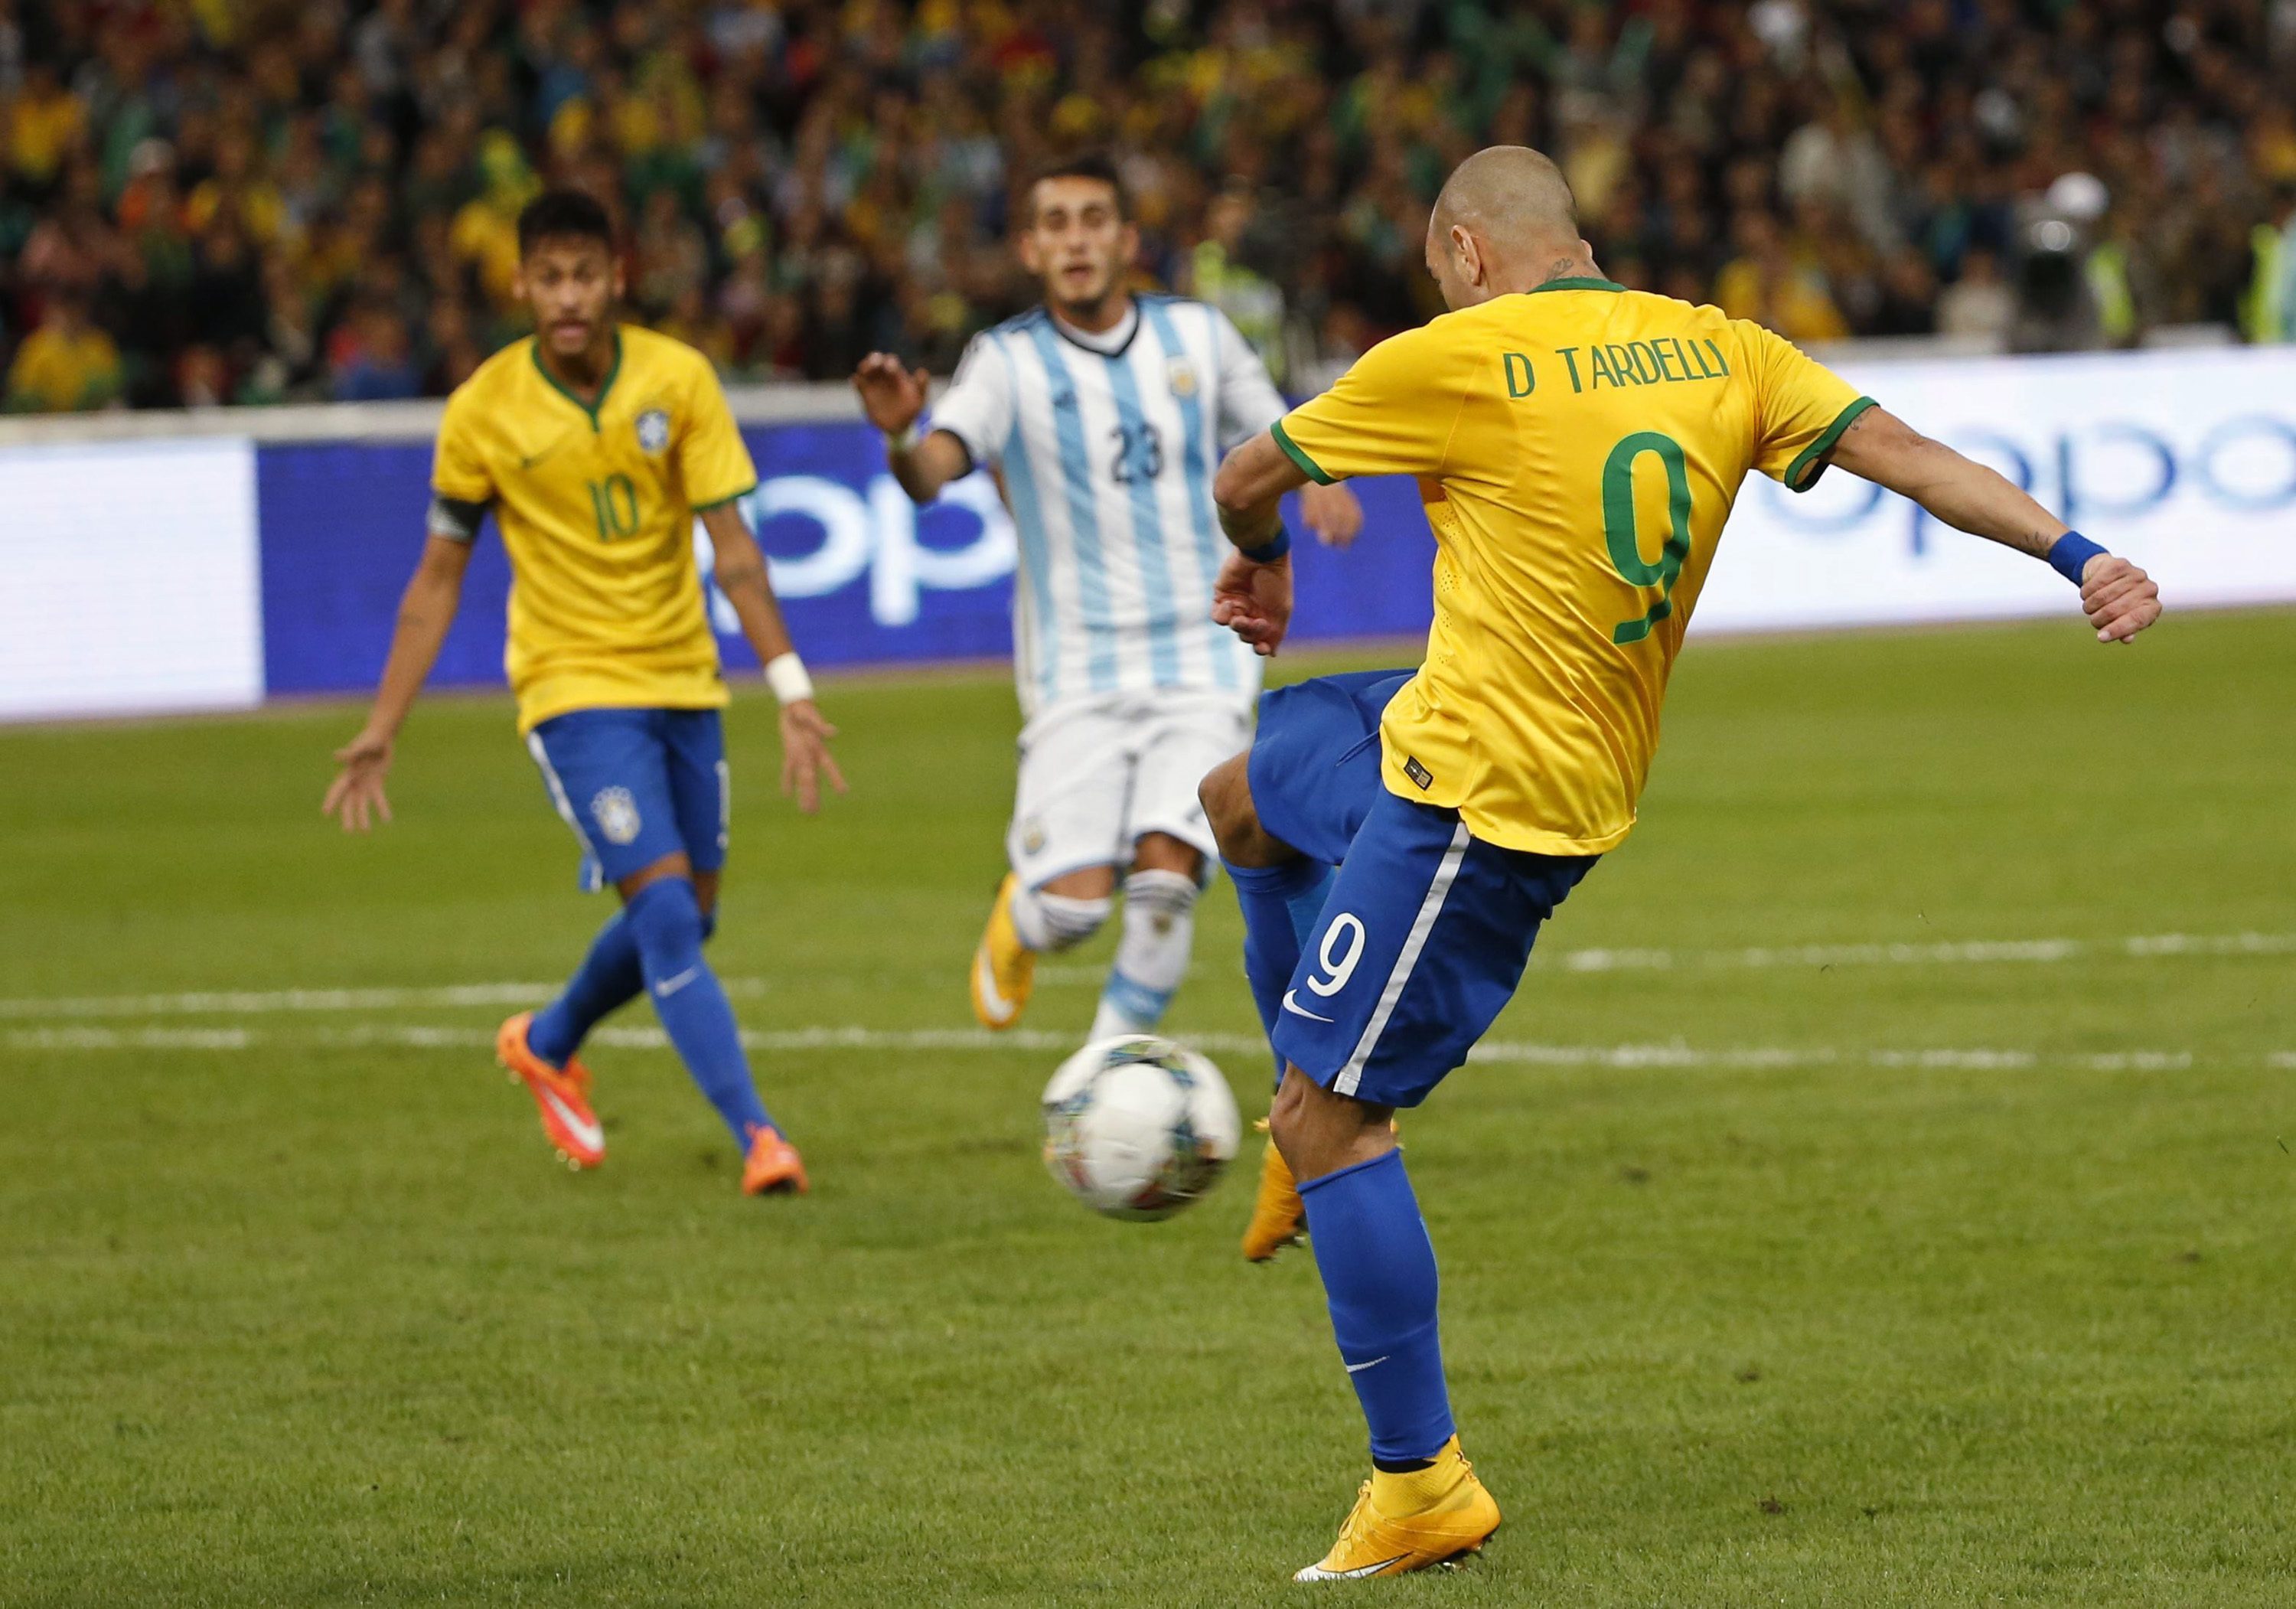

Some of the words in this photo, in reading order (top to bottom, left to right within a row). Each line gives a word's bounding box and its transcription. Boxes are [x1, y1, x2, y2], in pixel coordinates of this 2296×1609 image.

[1502, 352, 1536, 398] D
[1555, 338, 1730, 393] TARDELLI
[1109, 423, 1163, 485] 23
[585, 472, 640, 543] 10
[1601, 431, 1693, 645] 9
[1306, 911, 1366, 997] 9
